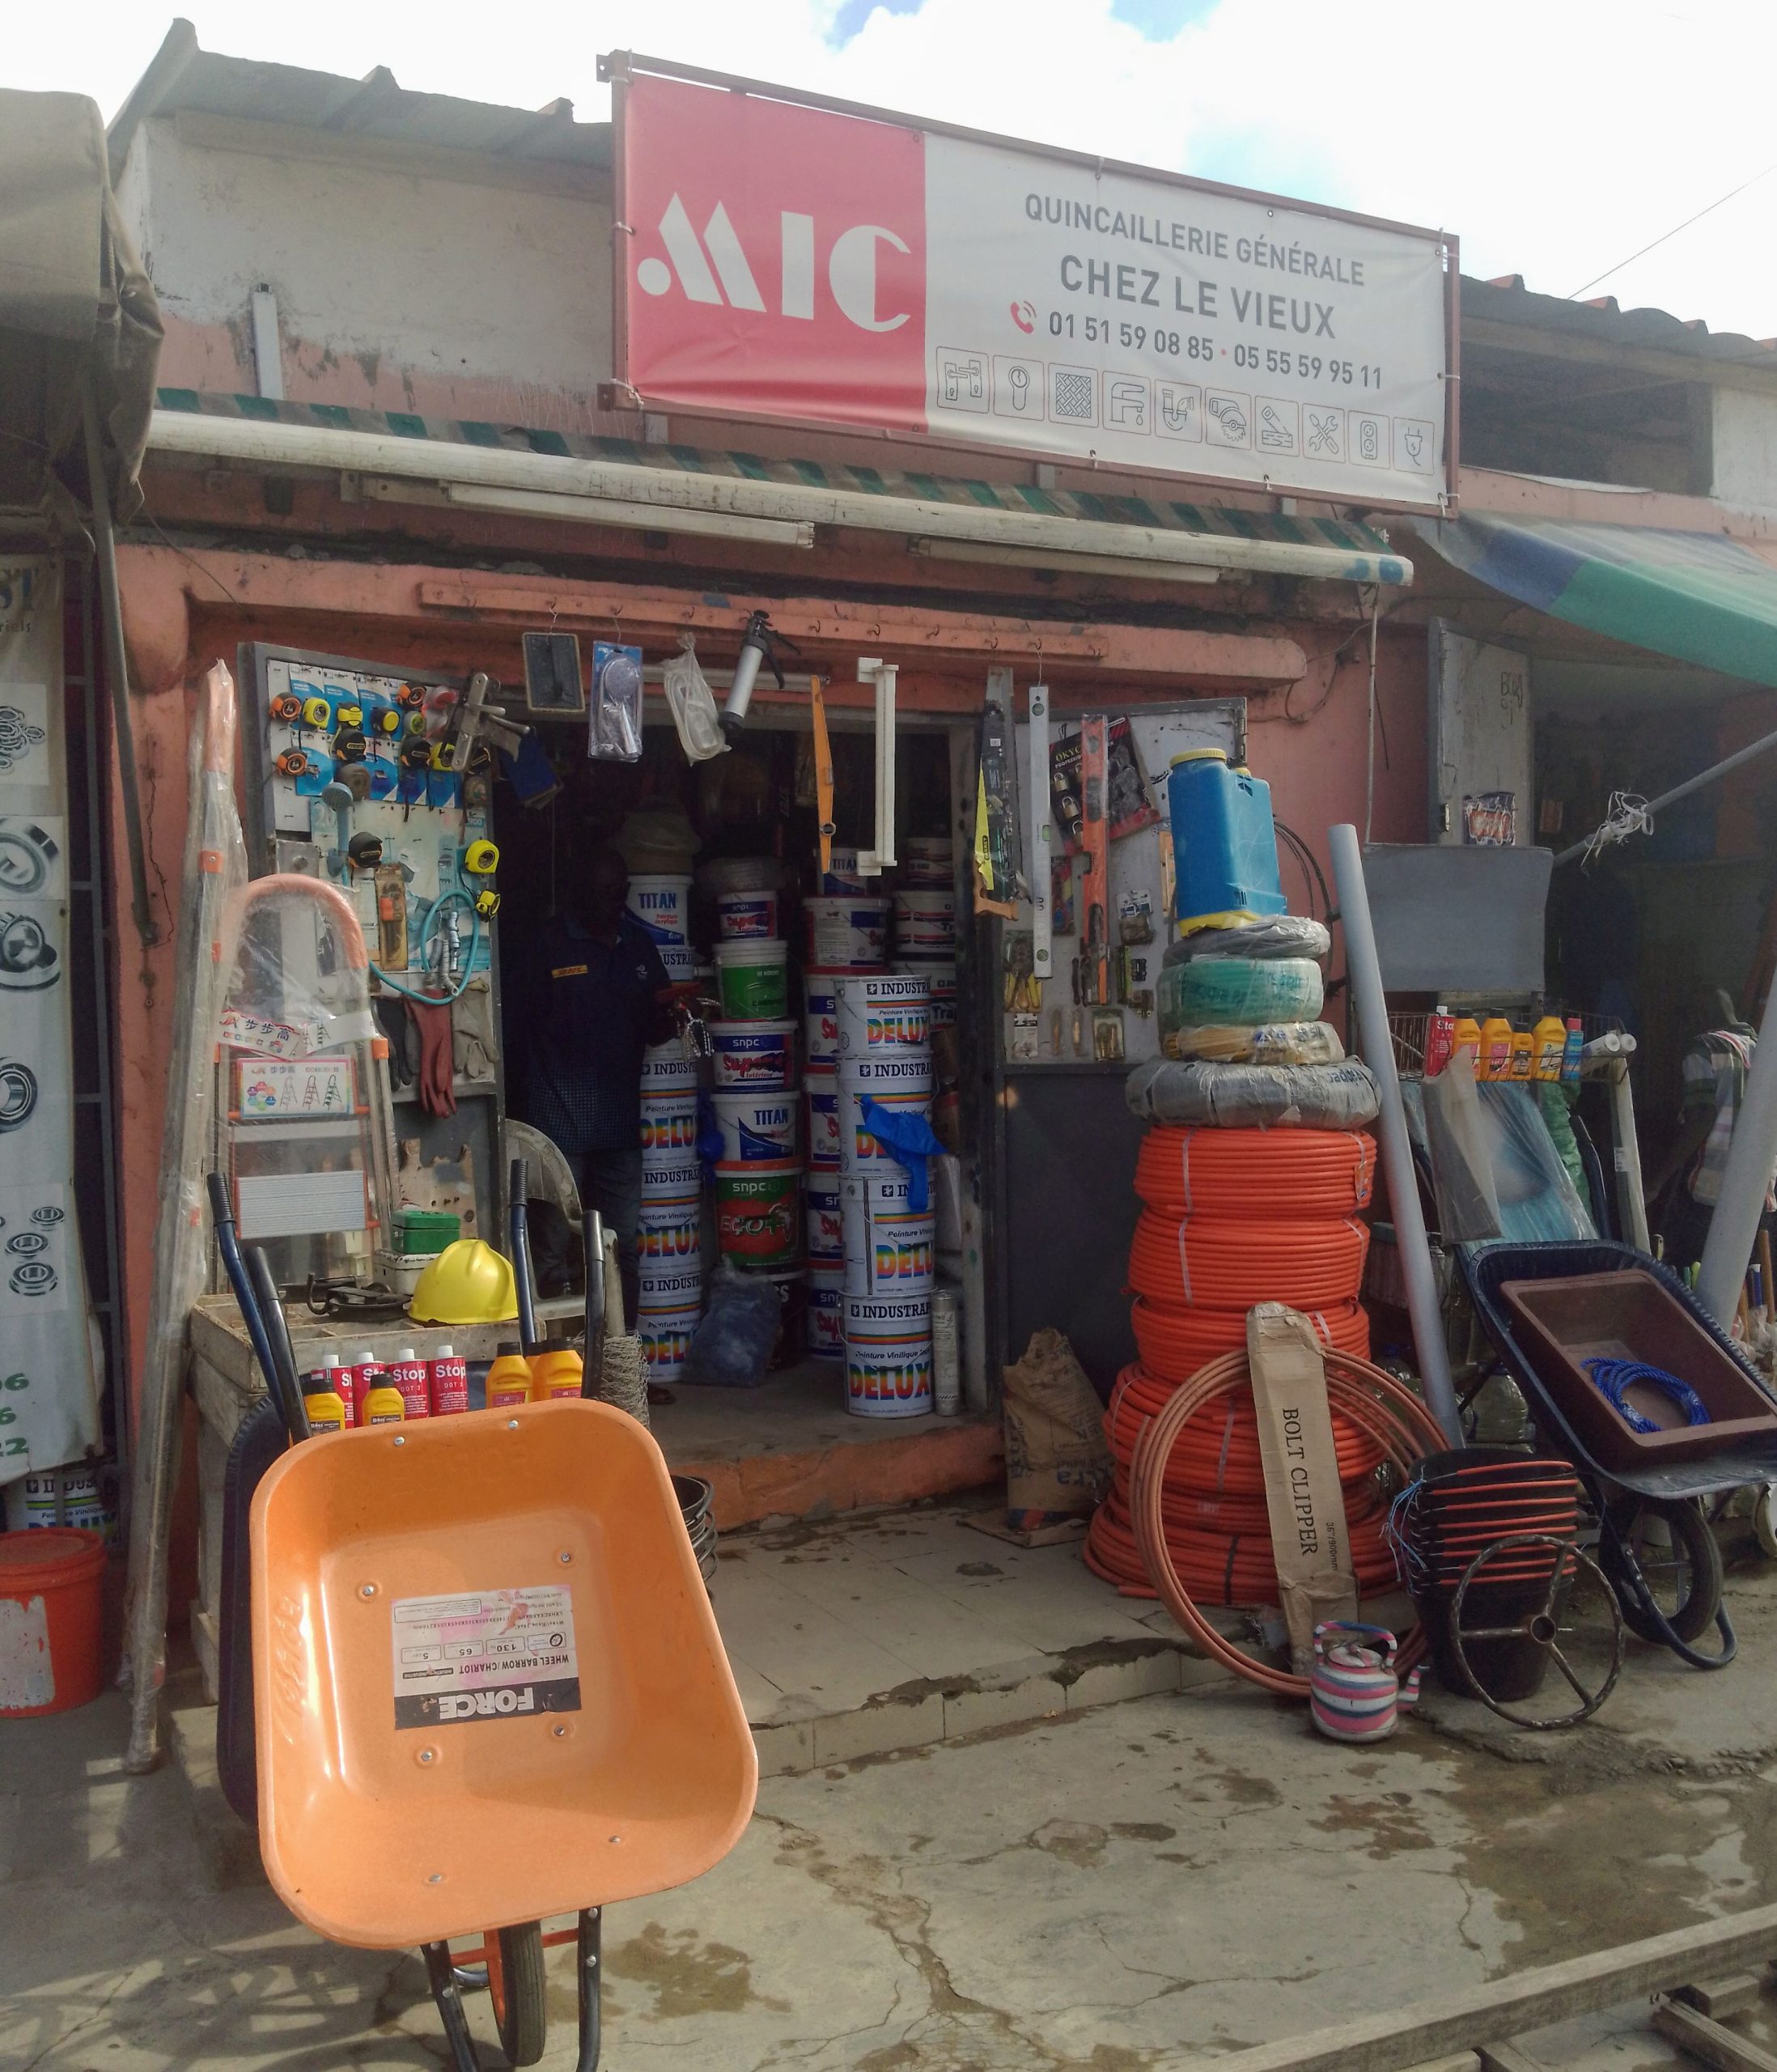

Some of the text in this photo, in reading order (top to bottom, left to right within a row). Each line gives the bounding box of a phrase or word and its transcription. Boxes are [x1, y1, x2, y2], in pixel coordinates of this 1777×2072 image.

[1024, 193, 1365, 286] QUINCAILLERIE GÉNÉRALE
[637, 191, 912, 333] MIC
[1060, 254, 1336, 339] CHEZ LE VIEUX
[1049, 311, 1382, 389] 01 51 59 08 85 05 55 59 95 11
[638, 893, 676, 909] TITAN
[244, 1019, 291, 1042] 步步高
[732, 1038, 760, 1049] snpc
[753, 1108, 789, 1126] TITAN
[732, 1182, 767, 1195] snpc
[393, 1367, 426, 1382] Stop
[435, 1364, 466, 1379] Stop
[848, 1361, 931, 1401] DELUX
[1282, 1407, 1319, 1556] BOLT CLIPPER
[422, 1651, 430, 1660] 5
[459, 1648, 473, 1657] 65
[496, 1643, 516, 1653] 130
[501, 1656, 538, 1670] BARROW
[538, 1654, 570, 1667] WHEEL
[438, 1687, 535, 1720] FORCE
